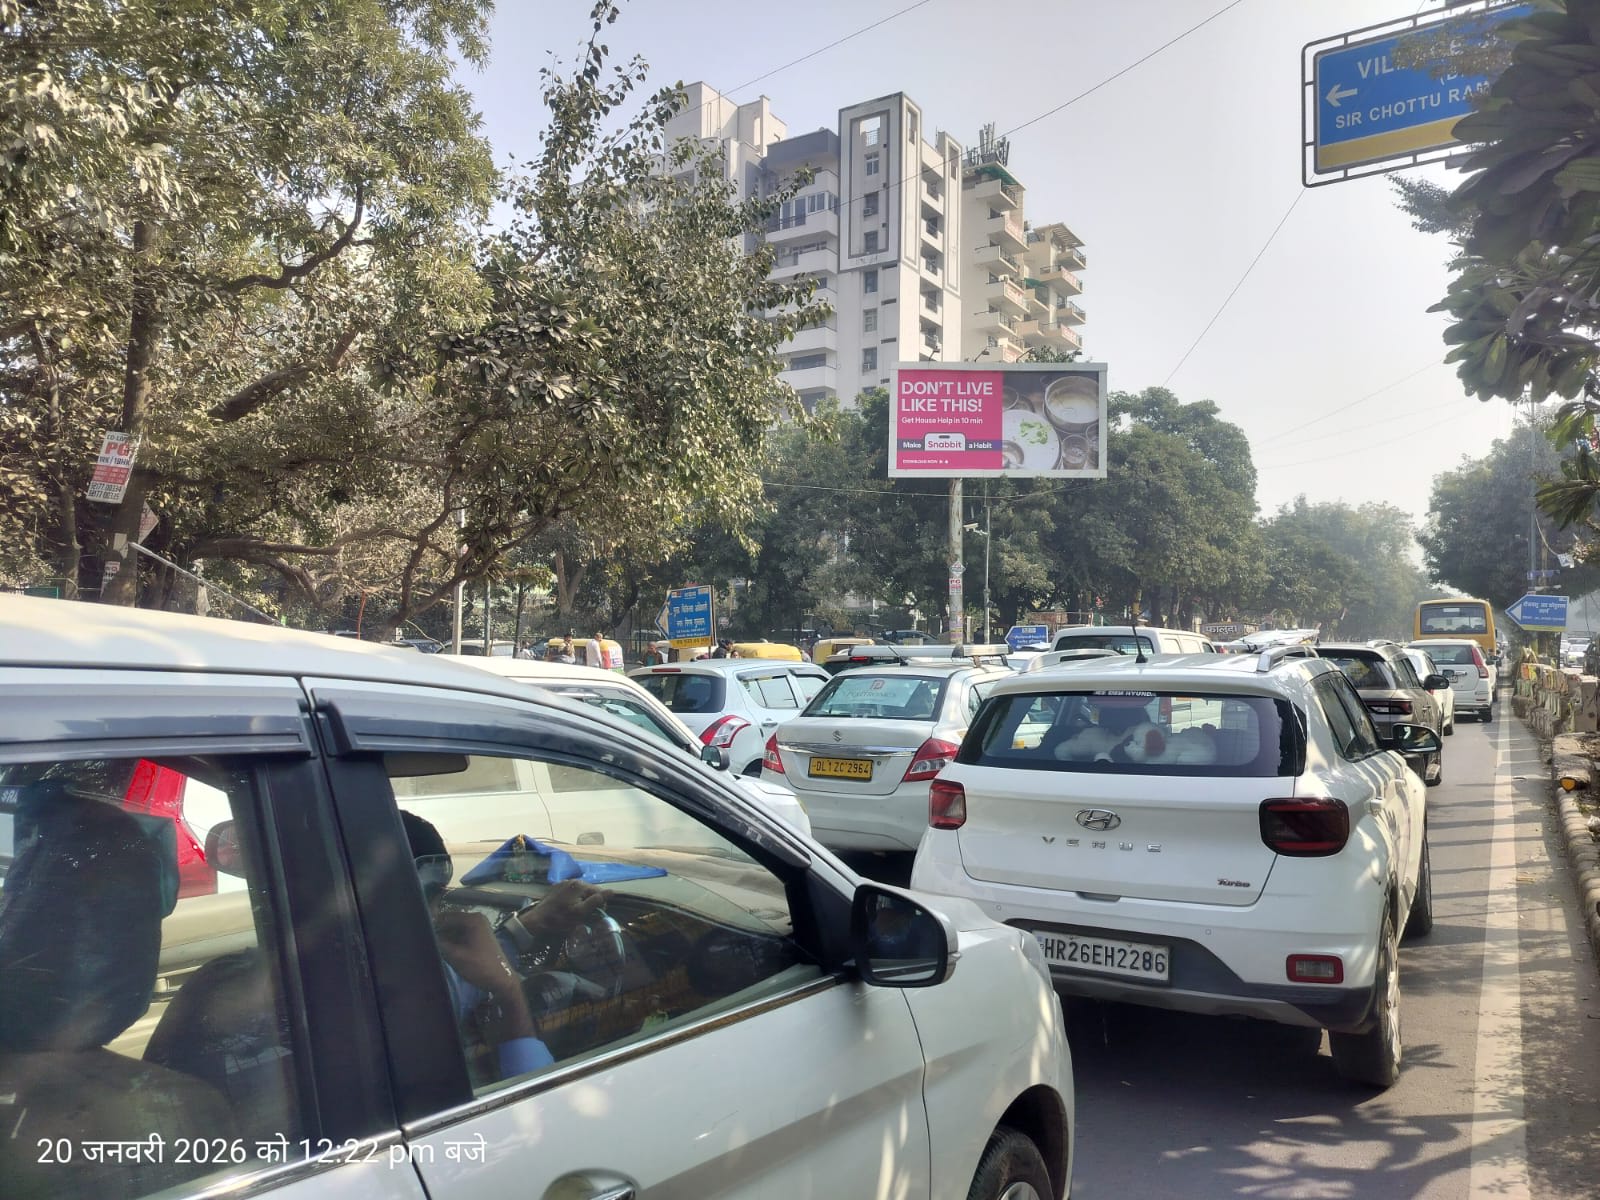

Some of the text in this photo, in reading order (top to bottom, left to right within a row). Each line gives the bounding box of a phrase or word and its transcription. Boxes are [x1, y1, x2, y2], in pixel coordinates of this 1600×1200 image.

[1335, 110, 1362, 129] SIR
[1369, 91, 1441, 121] CHOTTU
[901, 381, 993, 395] DON'T LIVE
[901, 399, 982, 412] LIKE THIS!
[937, 417, 953, 425] Help
[105, 441, 131, 457] PG
[902, 441, 921, 449] Make
[927, 440, 962, 449] Snabbit
[973, 441, 992, 449] Habit
[1041, 835, 1162, 853] VENUE
[1217, 878, 1251, 888] Turbo
[1044, 937, 1166, 974] HR26EH2286
